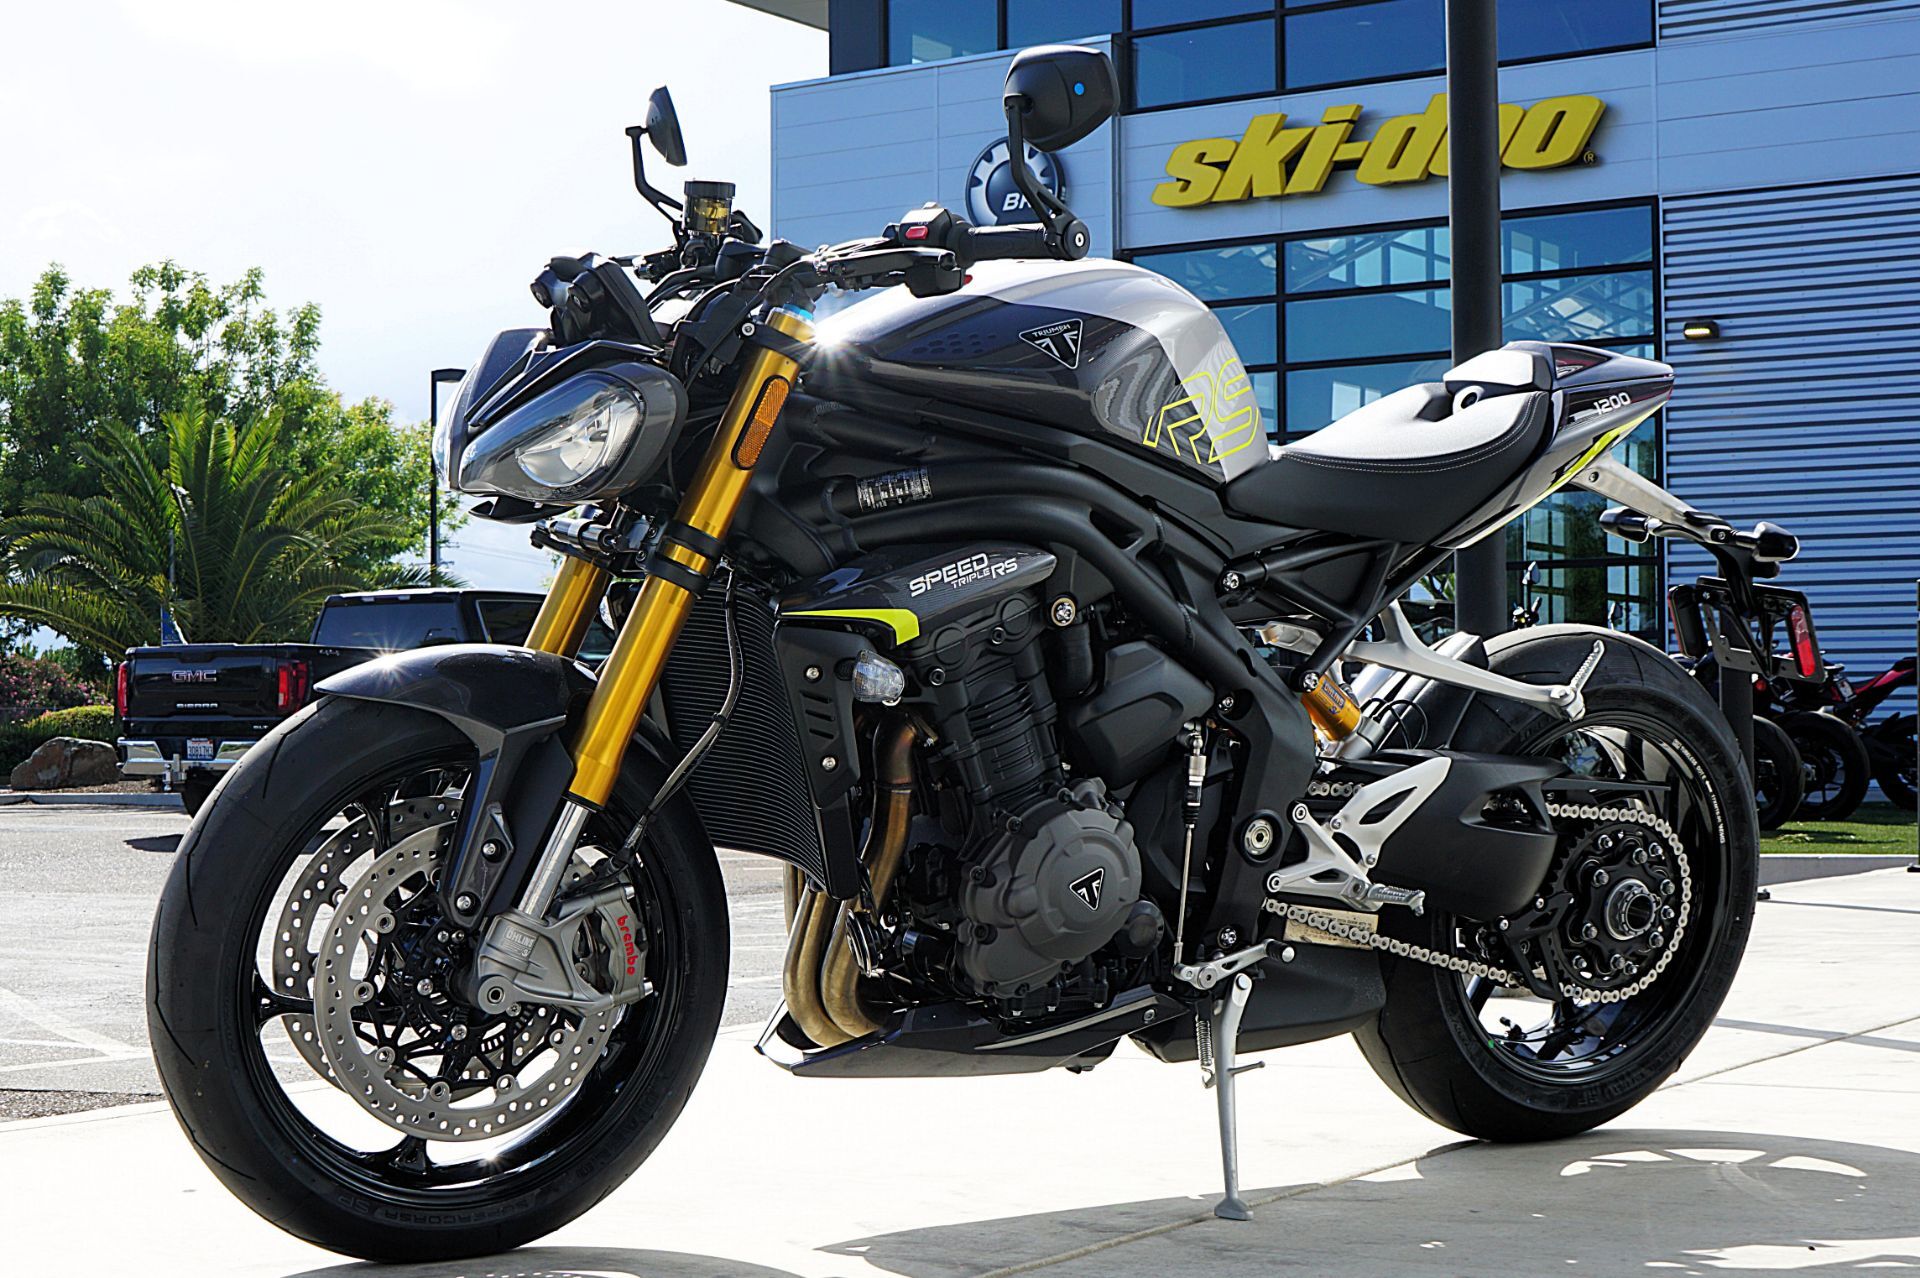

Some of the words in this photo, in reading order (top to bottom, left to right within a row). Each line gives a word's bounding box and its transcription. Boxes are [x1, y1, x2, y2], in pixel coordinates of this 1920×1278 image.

[1032, 323, 1071, 338] TRIUMPH
[1143, 357, 1259, 465] RS
[1593, 391, 1632, 415] 1200
[909, 552, 989, 598] SPEED
[950, 567, 991, 589] TRIPLE
[991, 557, 1018, 579] RS
[171, 669, 217, 683] GMC
[617, 914, 639, 976] brembo
